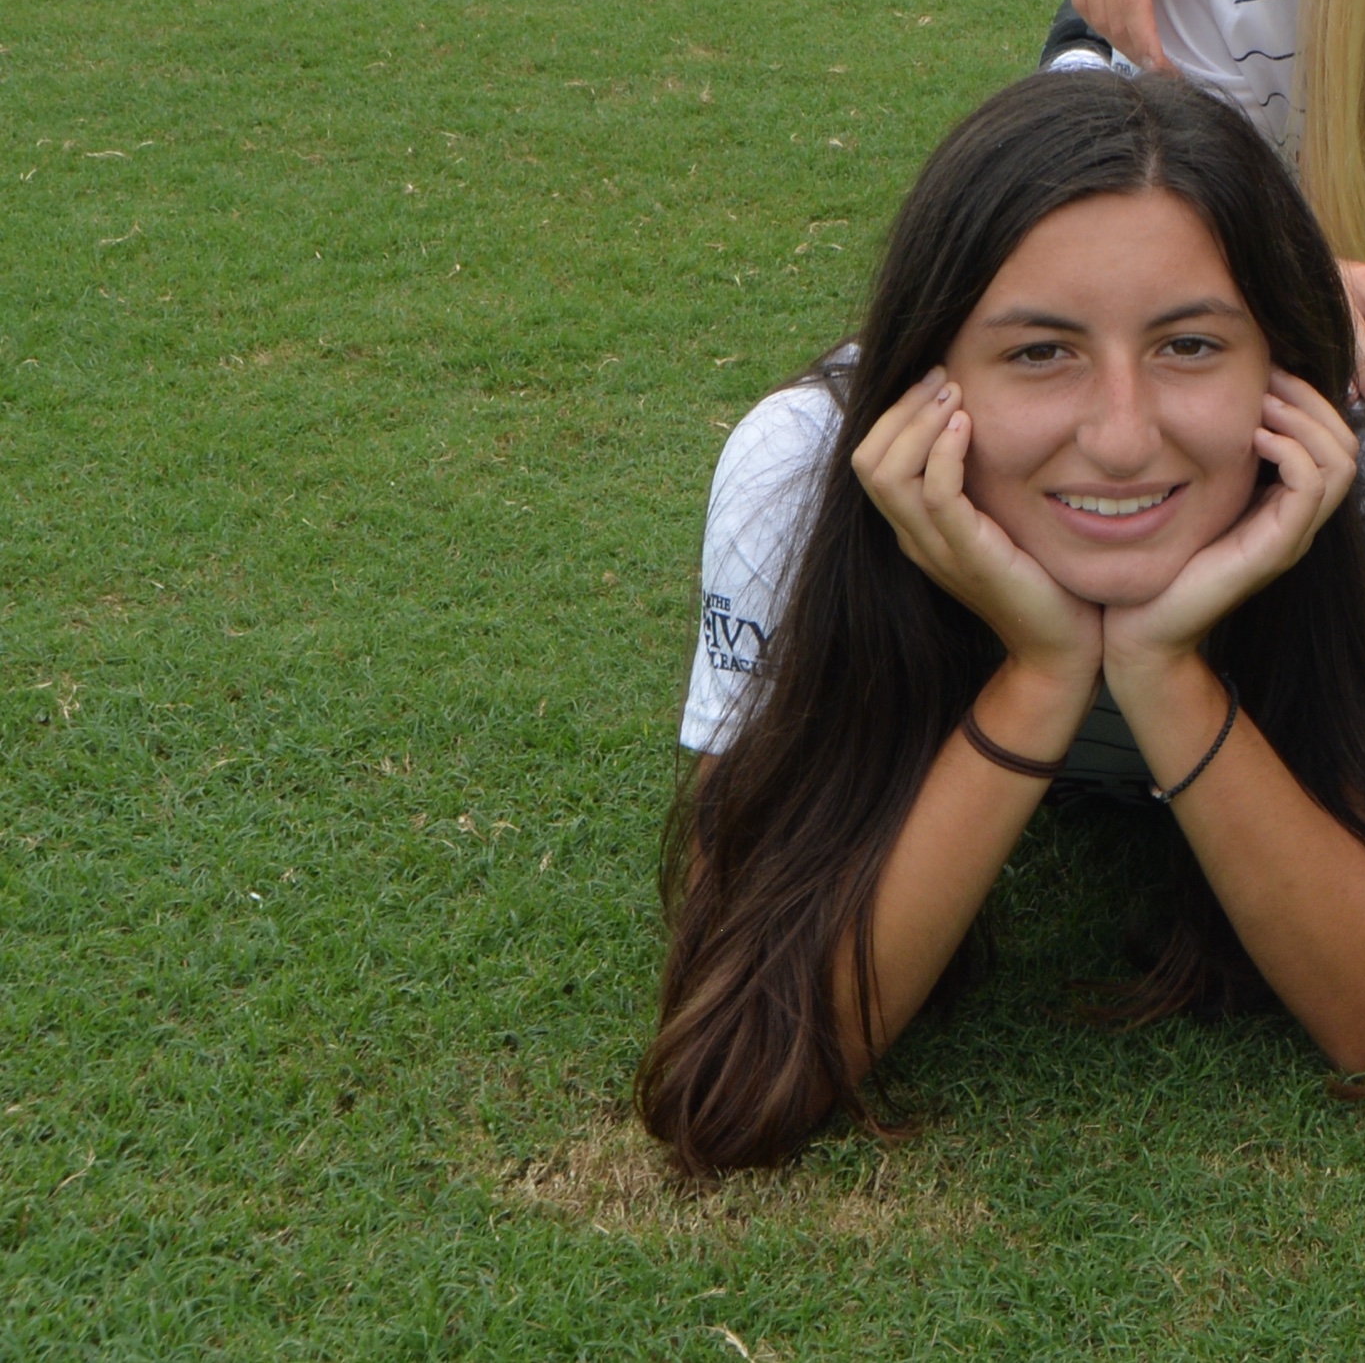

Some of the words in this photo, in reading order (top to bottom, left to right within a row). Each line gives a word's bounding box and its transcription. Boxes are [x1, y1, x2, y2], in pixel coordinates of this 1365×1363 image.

[710, 593, 731, 612] THE
[710, 610, 778, 661] IVY
[709, 651, 772, 677] LEAG
